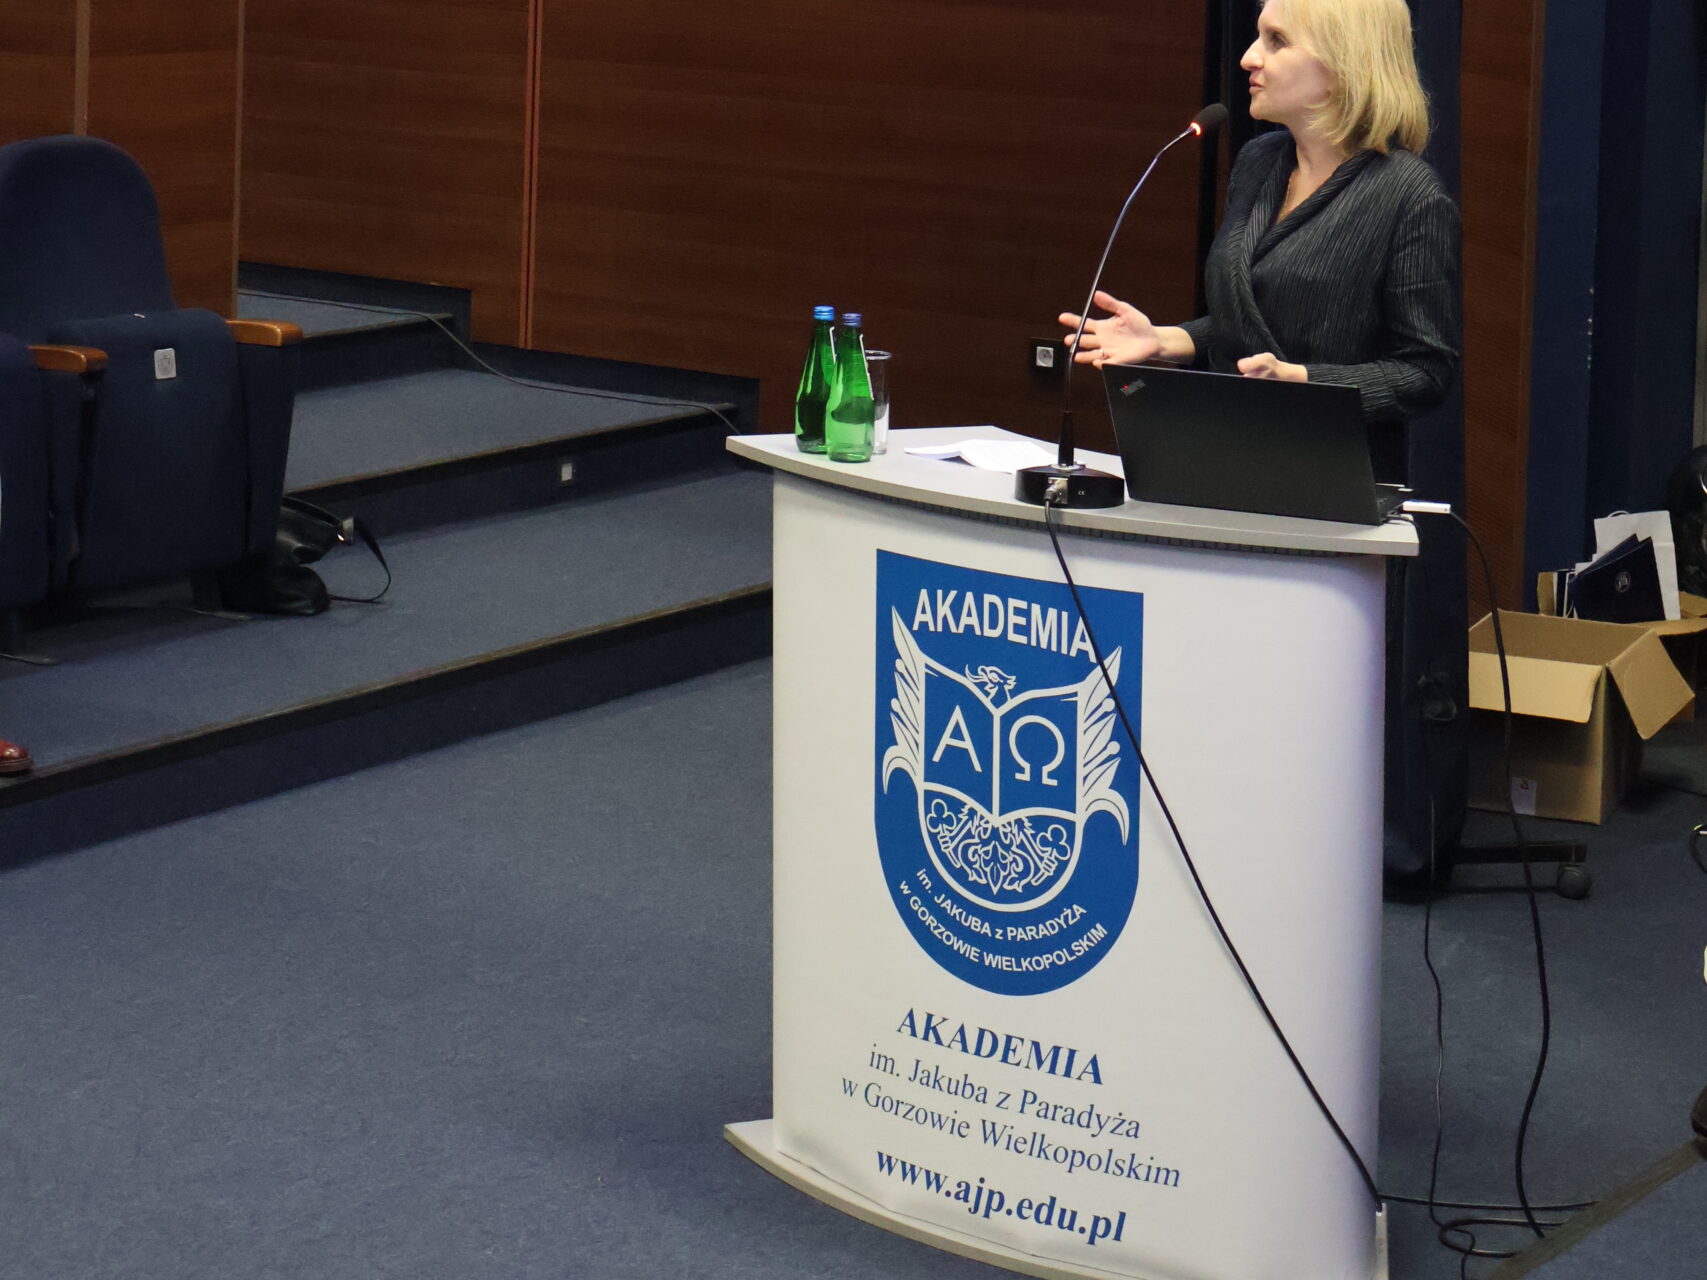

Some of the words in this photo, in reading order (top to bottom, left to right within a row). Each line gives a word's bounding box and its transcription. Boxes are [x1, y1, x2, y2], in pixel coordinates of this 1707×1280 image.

[912, 588, 1097, 663] AKADEMIA
[931, 705, 983, 773] A
[1008, 715, 1065, 786] Ω
[899, 881, 912, 895] w
[909, 896, 981, 962] GORZOWIE
[984, 922, 1108, 971] WIELKOPOLSKIM
[916, 868, 932, 893] im.
[934, 892, 992, 937] JAKUBA
[995, 928, 1003, 940] z
[1007, 904, 1087, 941] PARADYŻA
[896, 1007, 1104, 1086] AKADEMIA
[842, 1078, 858, 1097] w
[863, 1081, 971, 1139] Gorzowie
[979, 1118, 1181, 1188] Wielkopolskim
[868, 1042, 901, 1078] im.
[908, 1058, 989, 1104] Jakuba
[995, 1091, 1011, 1110] z
[1019, 1089, 1141, 1139] Paradyża
[876, 1150, 1127, 1246] www.ajp.edu.pl
